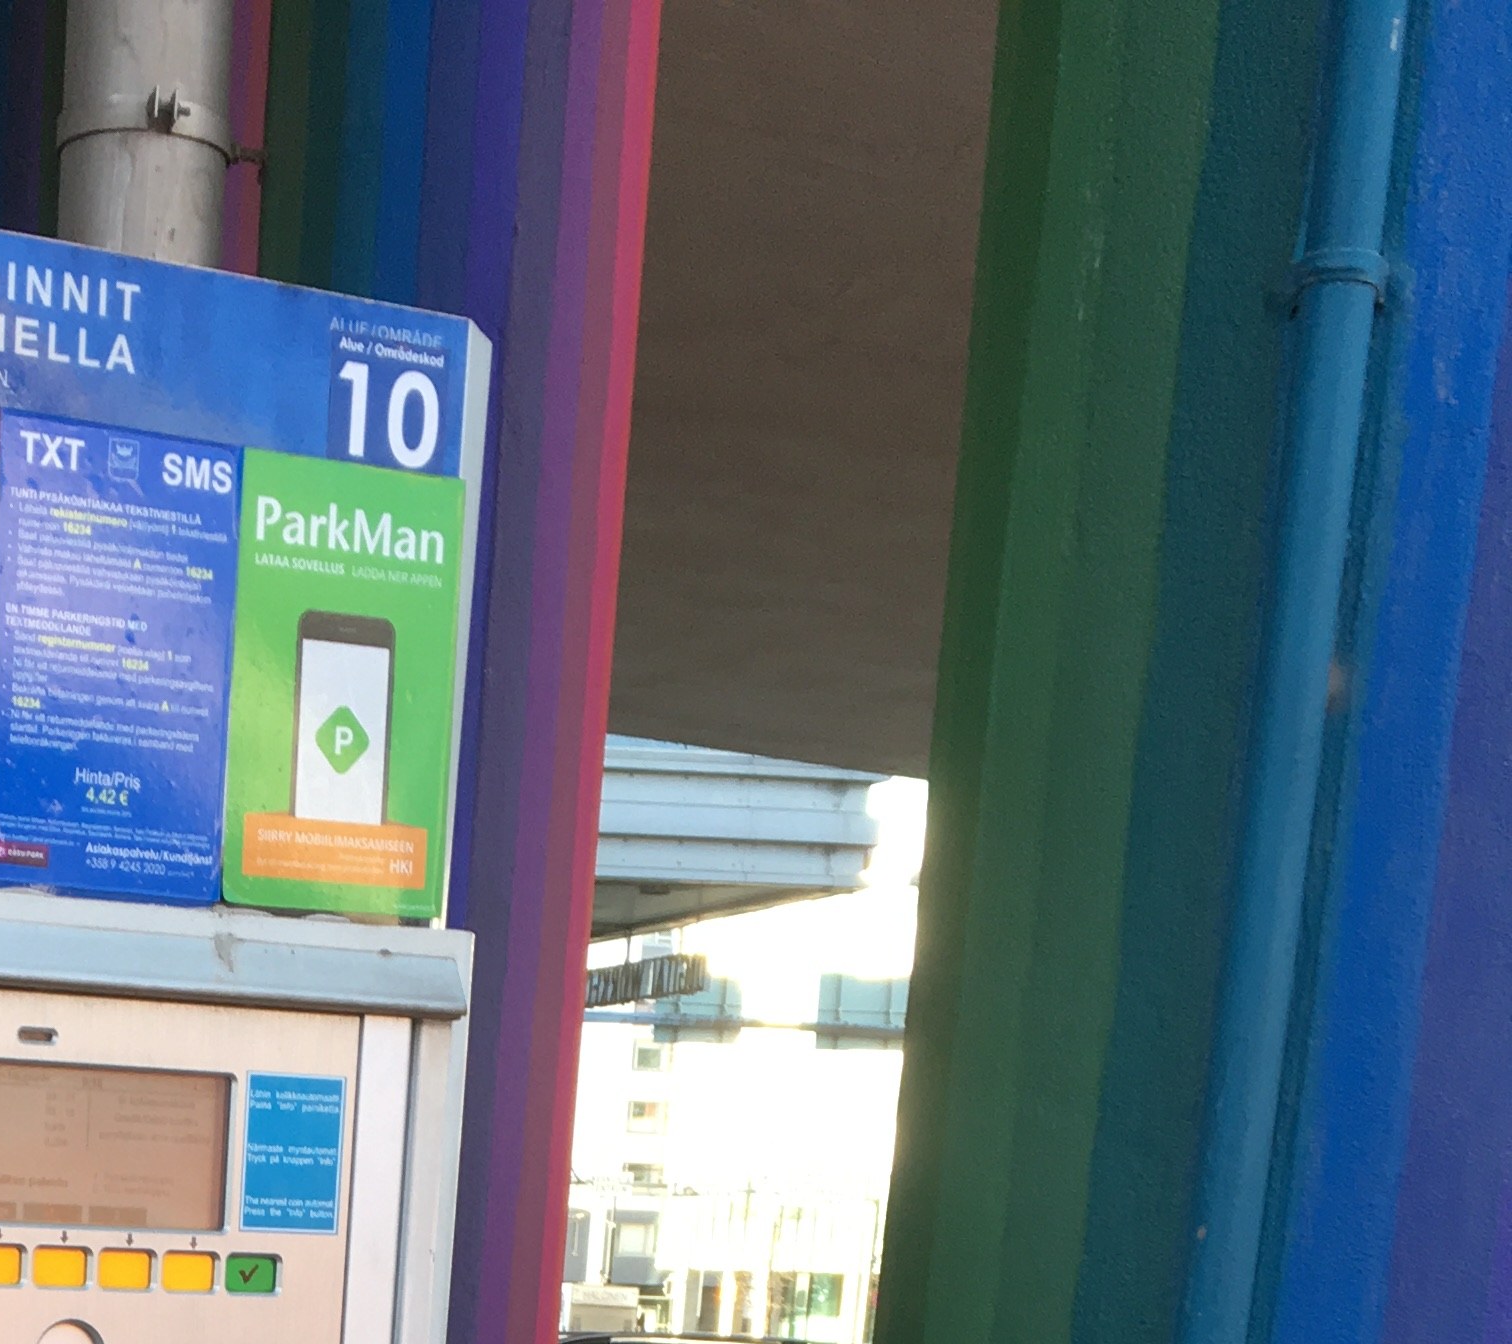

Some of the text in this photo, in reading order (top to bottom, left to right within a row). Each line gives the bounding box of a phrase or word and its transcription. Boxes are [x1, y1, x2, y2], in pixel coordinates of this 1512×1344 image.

[339, 336, 364, 353] Alue
[375, 342, 445, 368] Områdeskod
[339, 360, 438, 469] 10
[19, 430, 232, 494] TXT SMS
[10, 486, 37, 499] TUNTI
[256, 494, 445, 565] ParkMan
[254, 552, 442, 588] LATAA SOVELLUS LADDA NER APPEN
[334, 725, 353, 756] P
[75, 767, 141, 790] Hinta/Pris
[257, 828, 414, 853] SIIRRY MOBIILIMAKSAMISEEN
[143, 862, 166, 876] 2020
[390, 859, 413, 875] HKI
